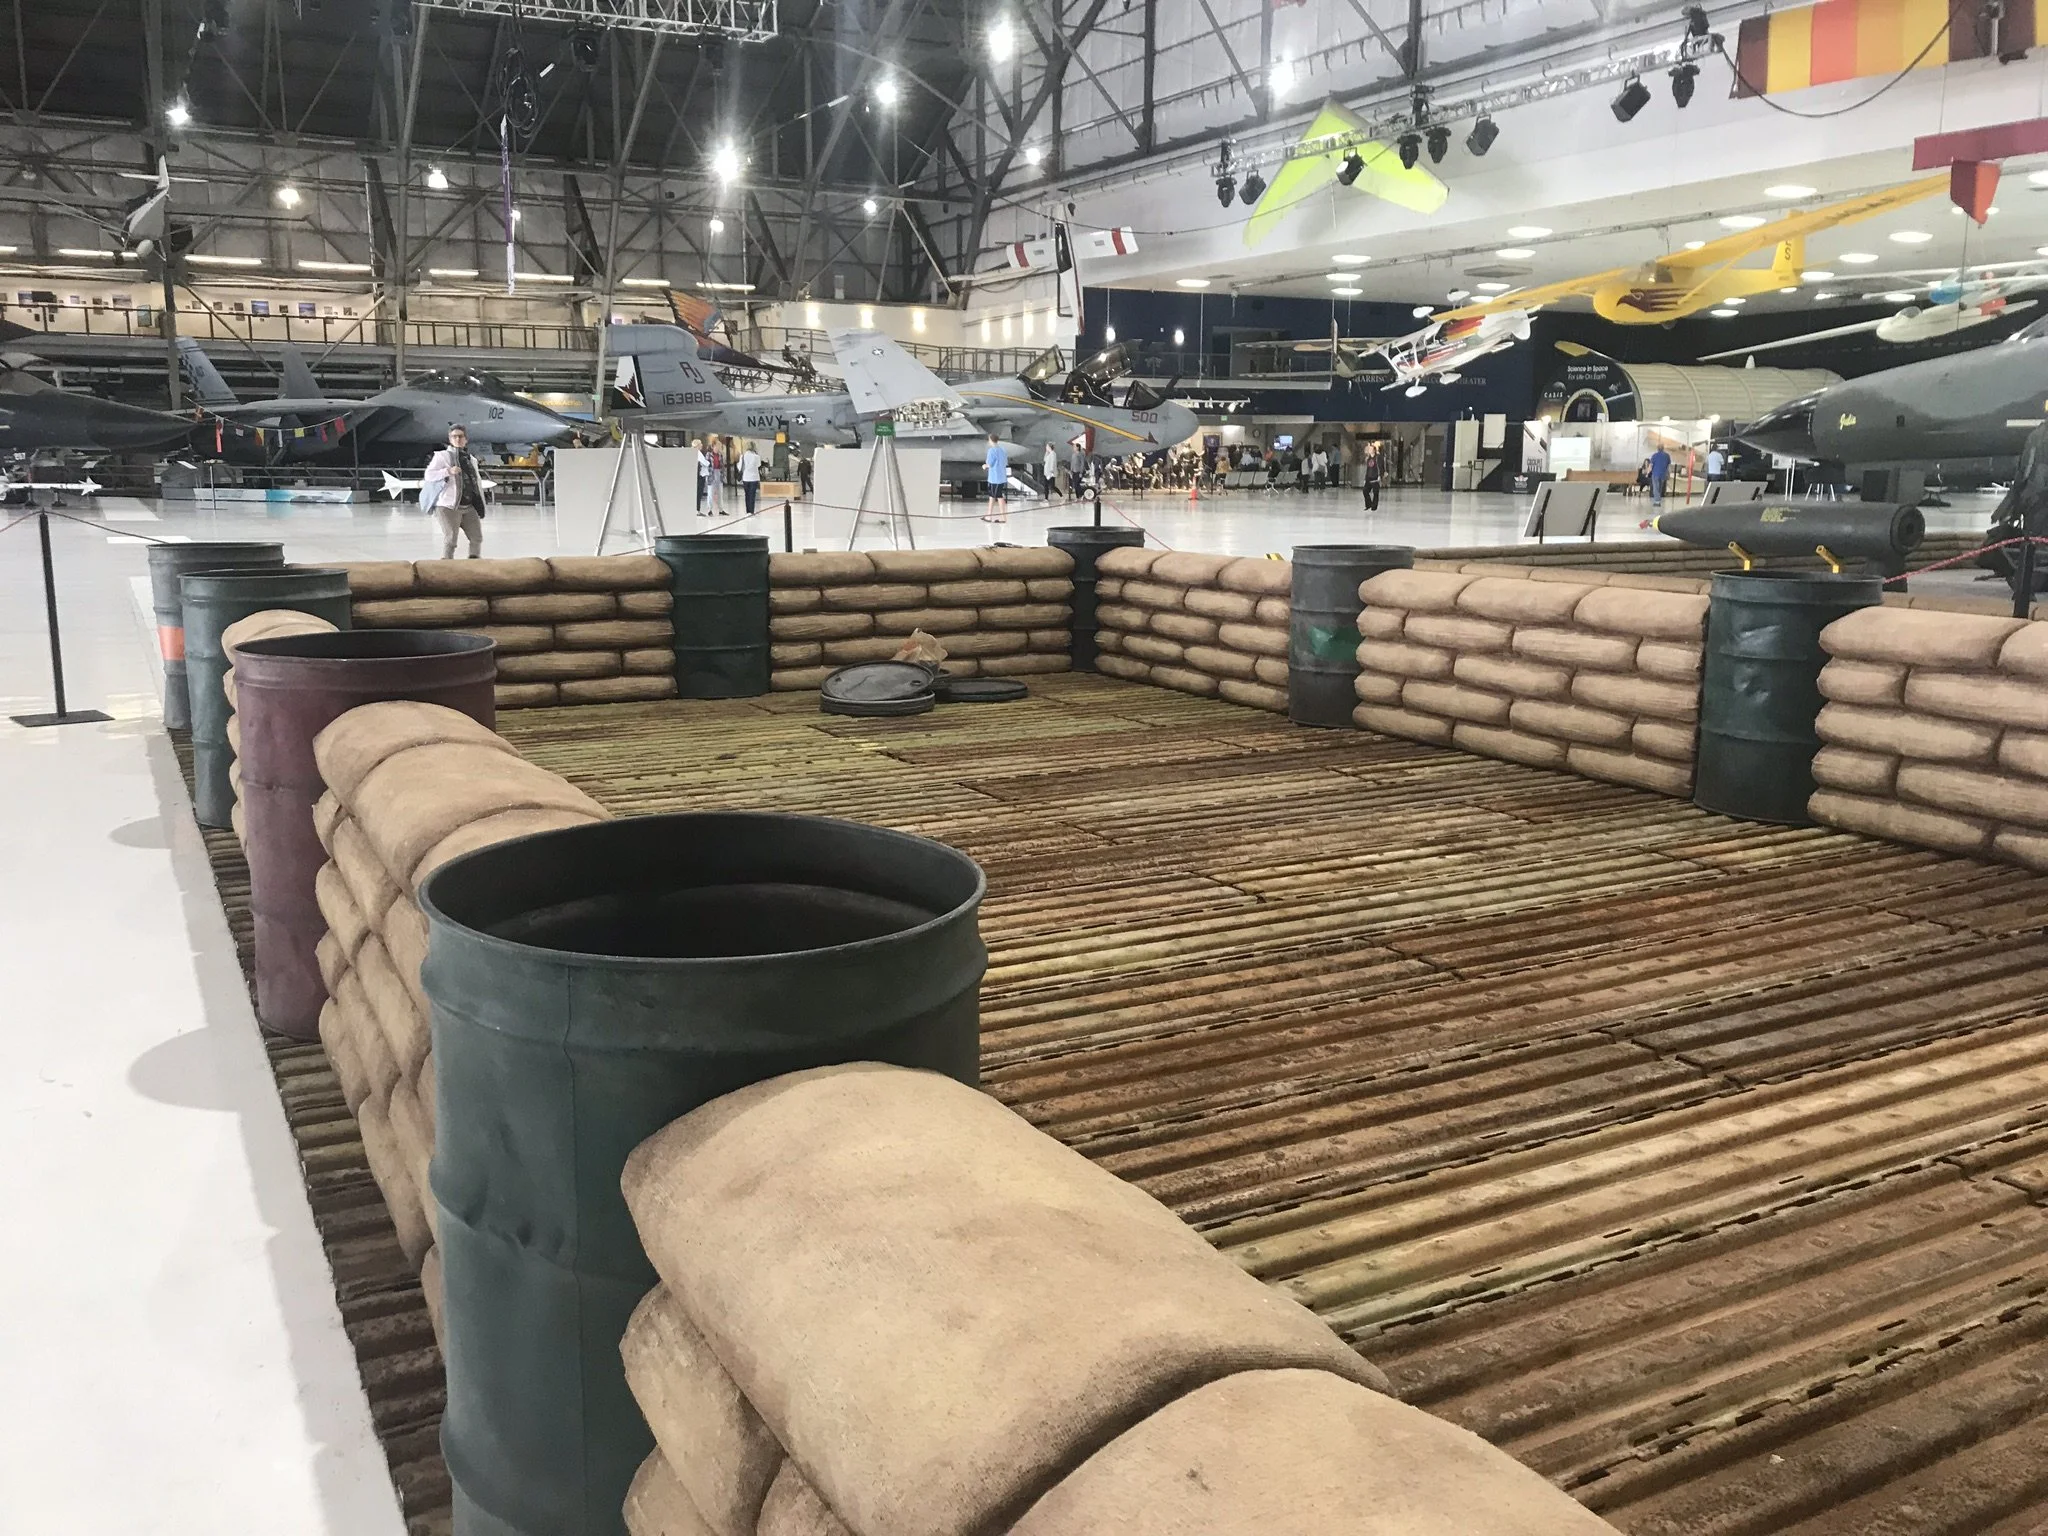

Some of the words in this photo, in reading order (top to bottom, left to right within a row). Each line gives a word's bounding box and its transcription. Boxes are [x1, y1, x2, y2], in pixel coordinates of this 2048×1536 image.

[1593, 365, 1608, 373] Space
[662, 391, 713, 406] 163886
[488, 407, 505, 419] 102
[1131, 411, 1158, 424] 500
[747, 414, 784, 430] NAVY
